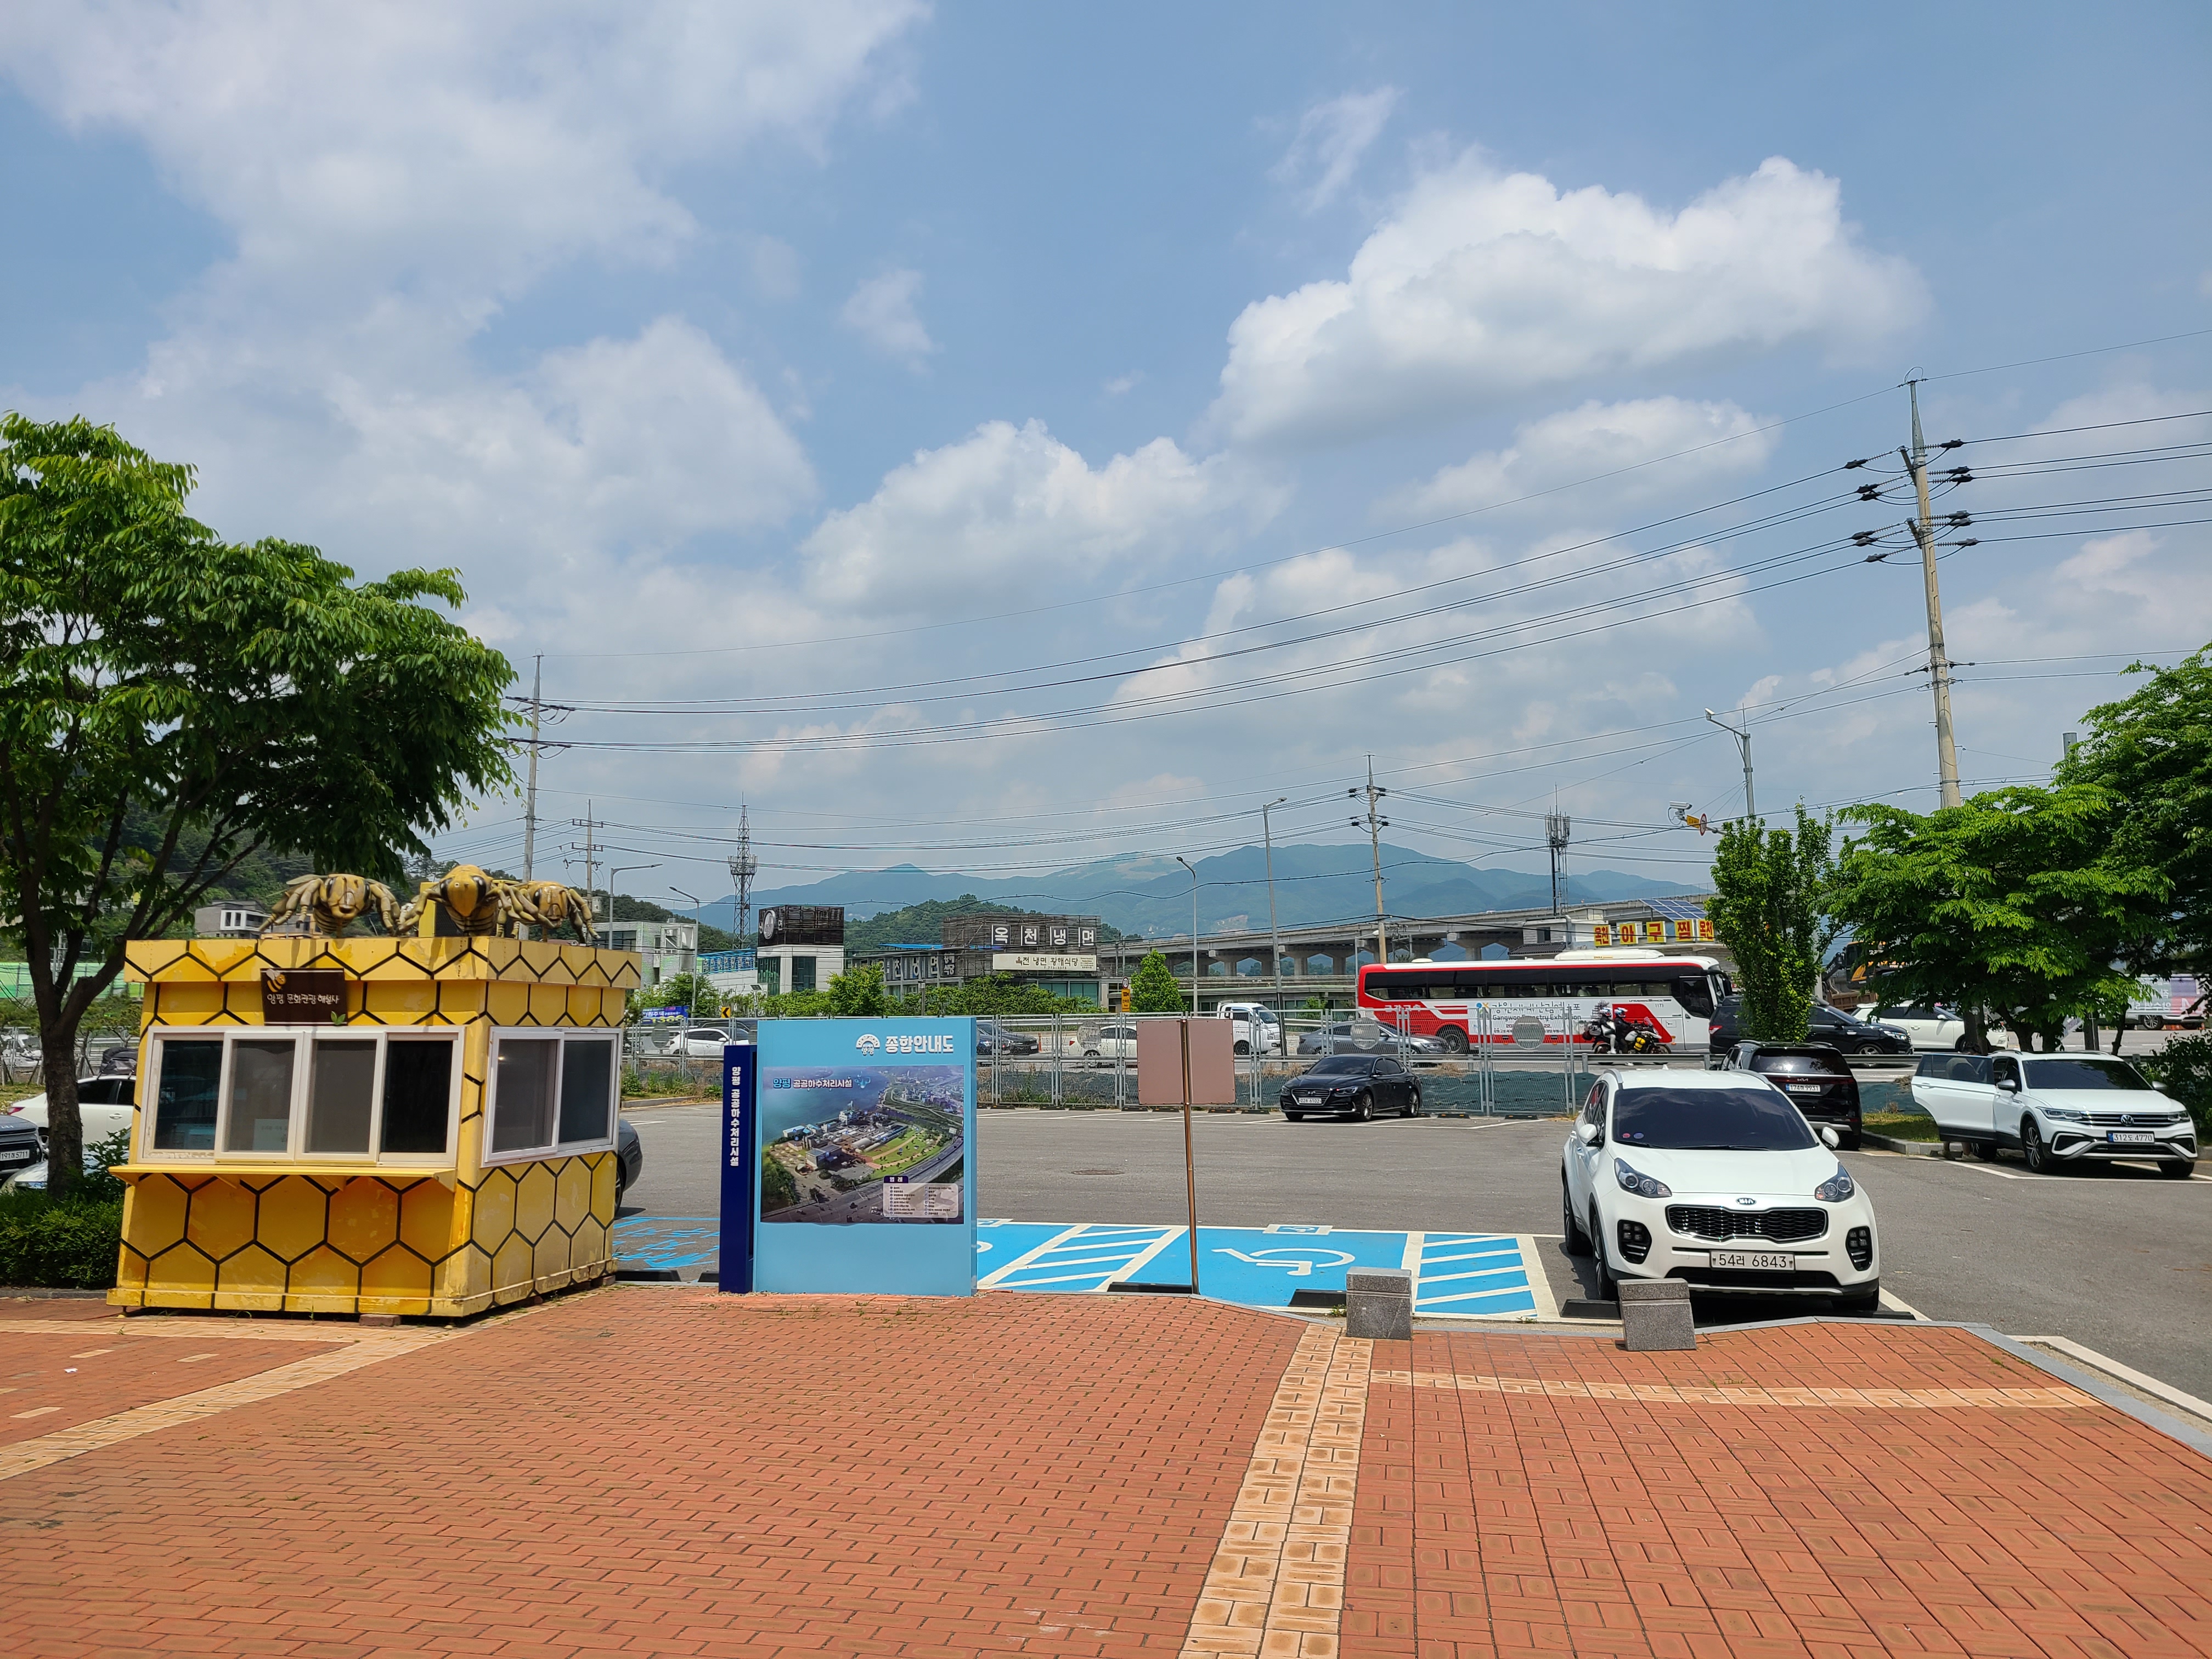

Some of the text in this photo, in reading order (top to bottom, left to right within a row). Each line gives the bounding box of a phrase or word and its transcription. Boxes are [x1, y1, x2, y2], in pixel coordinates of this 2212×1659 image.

[1015, 956, 1030, 966] 옥천
[1033, 957, 1047, 966] 냉면
[1050, 957, 1079, 967] 황해식당
[267, 994, 284, 1005] 양평
[885, 1035, 953, 1053] 종합안내도
[774, 1078, 853, 1088] 양평 공공하수처리시설
[730, 1066, 741, 1166] 양평 공공하수처리시설
[1719, 1255, 1787, 1268] 54러 6843
